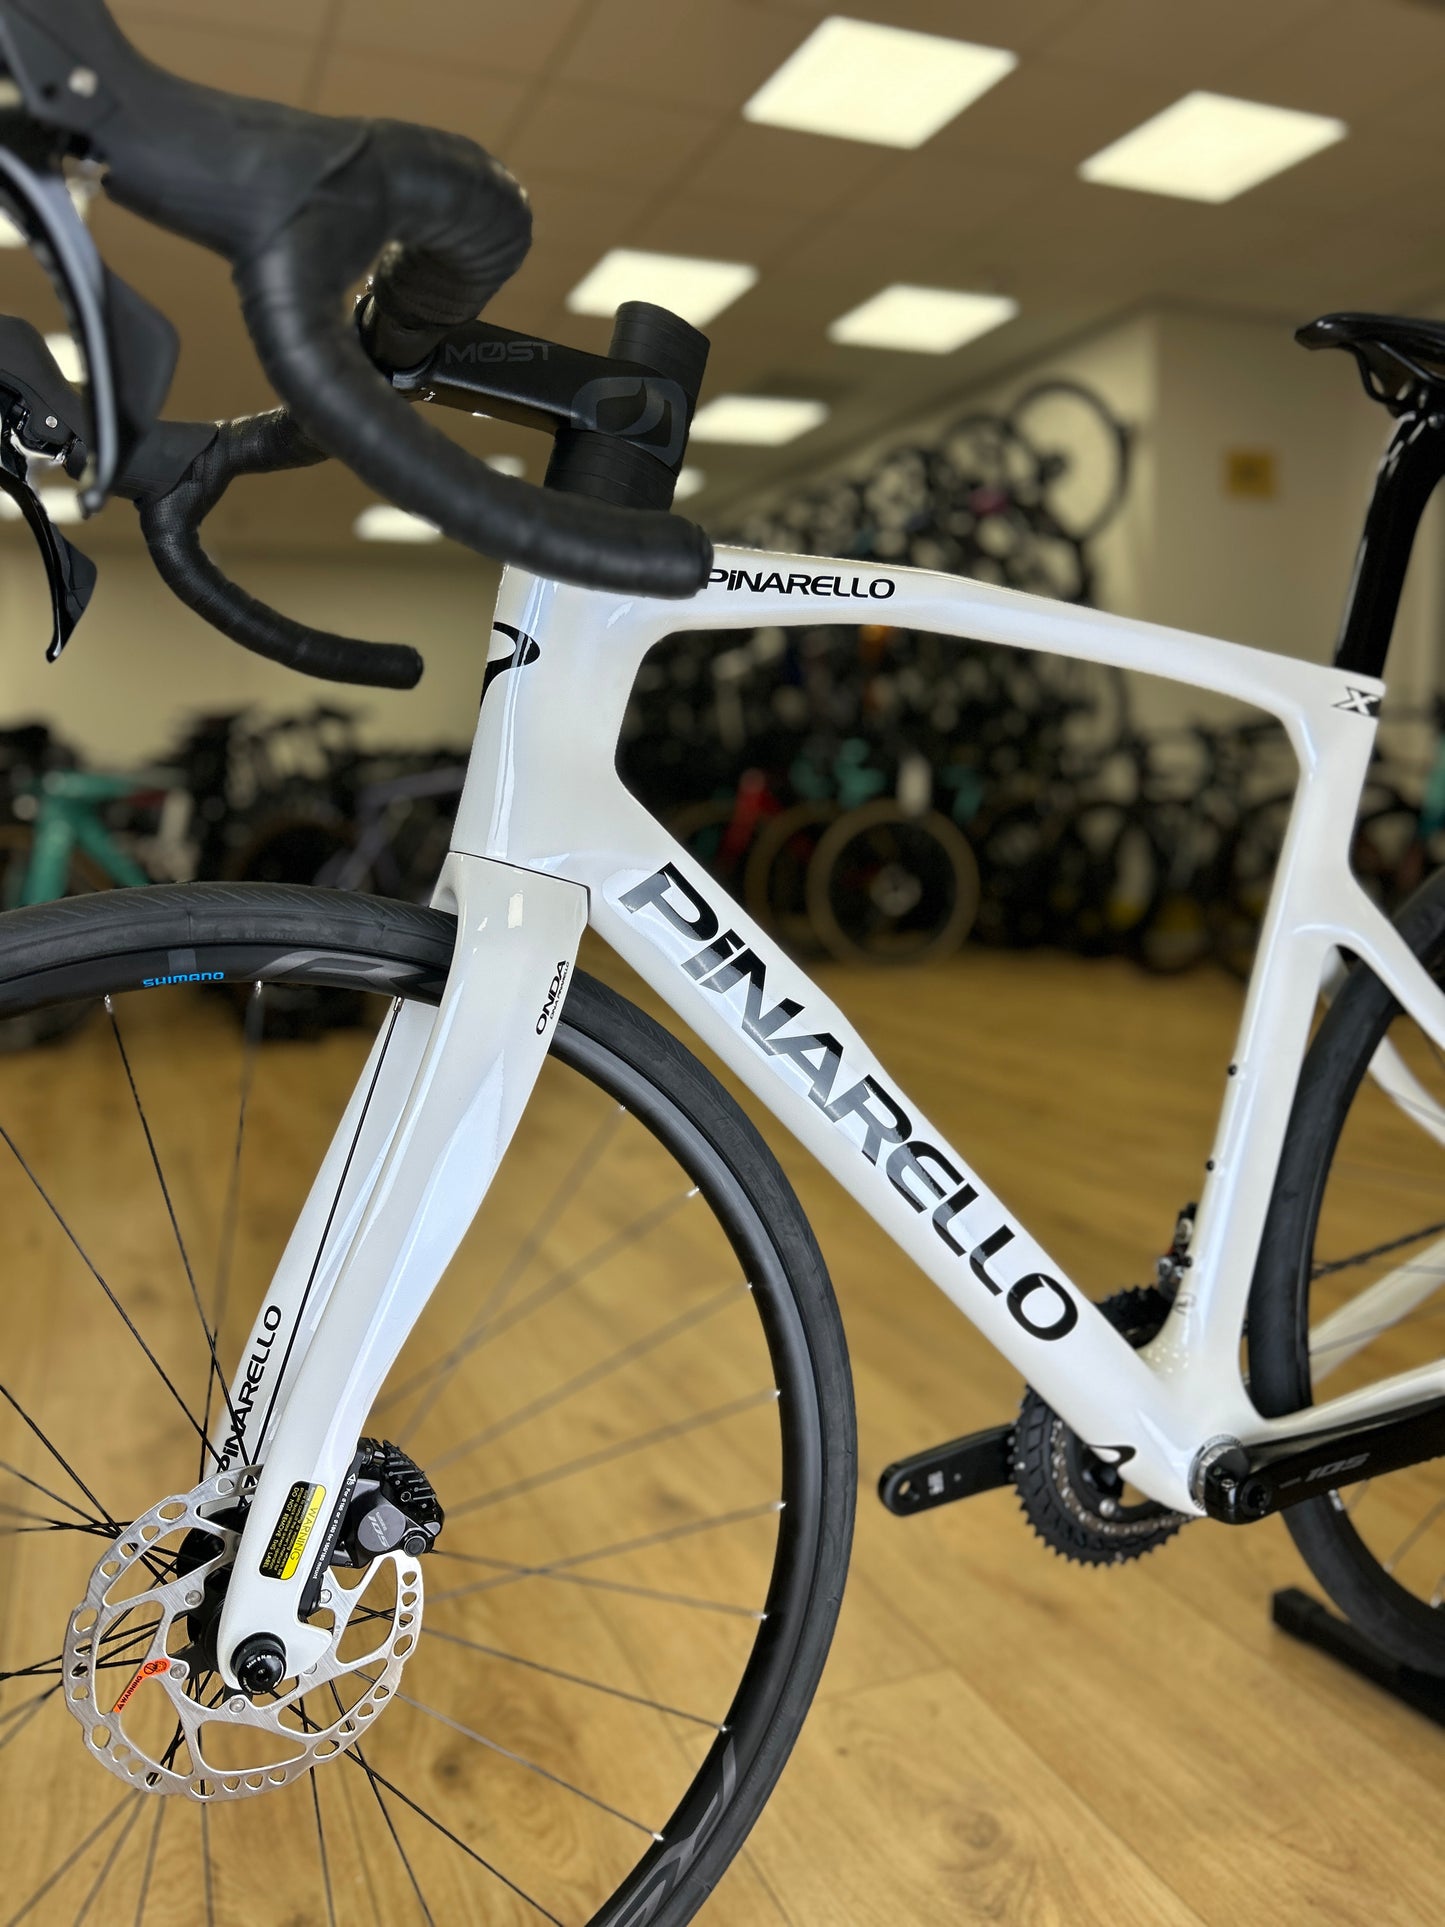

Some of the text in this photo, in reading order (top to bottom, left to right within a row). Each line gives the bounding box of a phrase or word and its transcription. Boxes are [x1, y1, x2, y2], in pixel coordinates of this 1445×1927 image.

[142, 971, 225, 988] SHIMANO
[536, 960, 567, 1035] ONDA
[1305, 1452, 1371, 1482] 105
[285, 1498, 294, 1511] NOT
[291, 1486, 299, 1497] DO
[290, 1506, 318, 1561] WARNING
[367, 1515, 391, 1548] 105
[120, 1675, 143, 1703] WARNING
